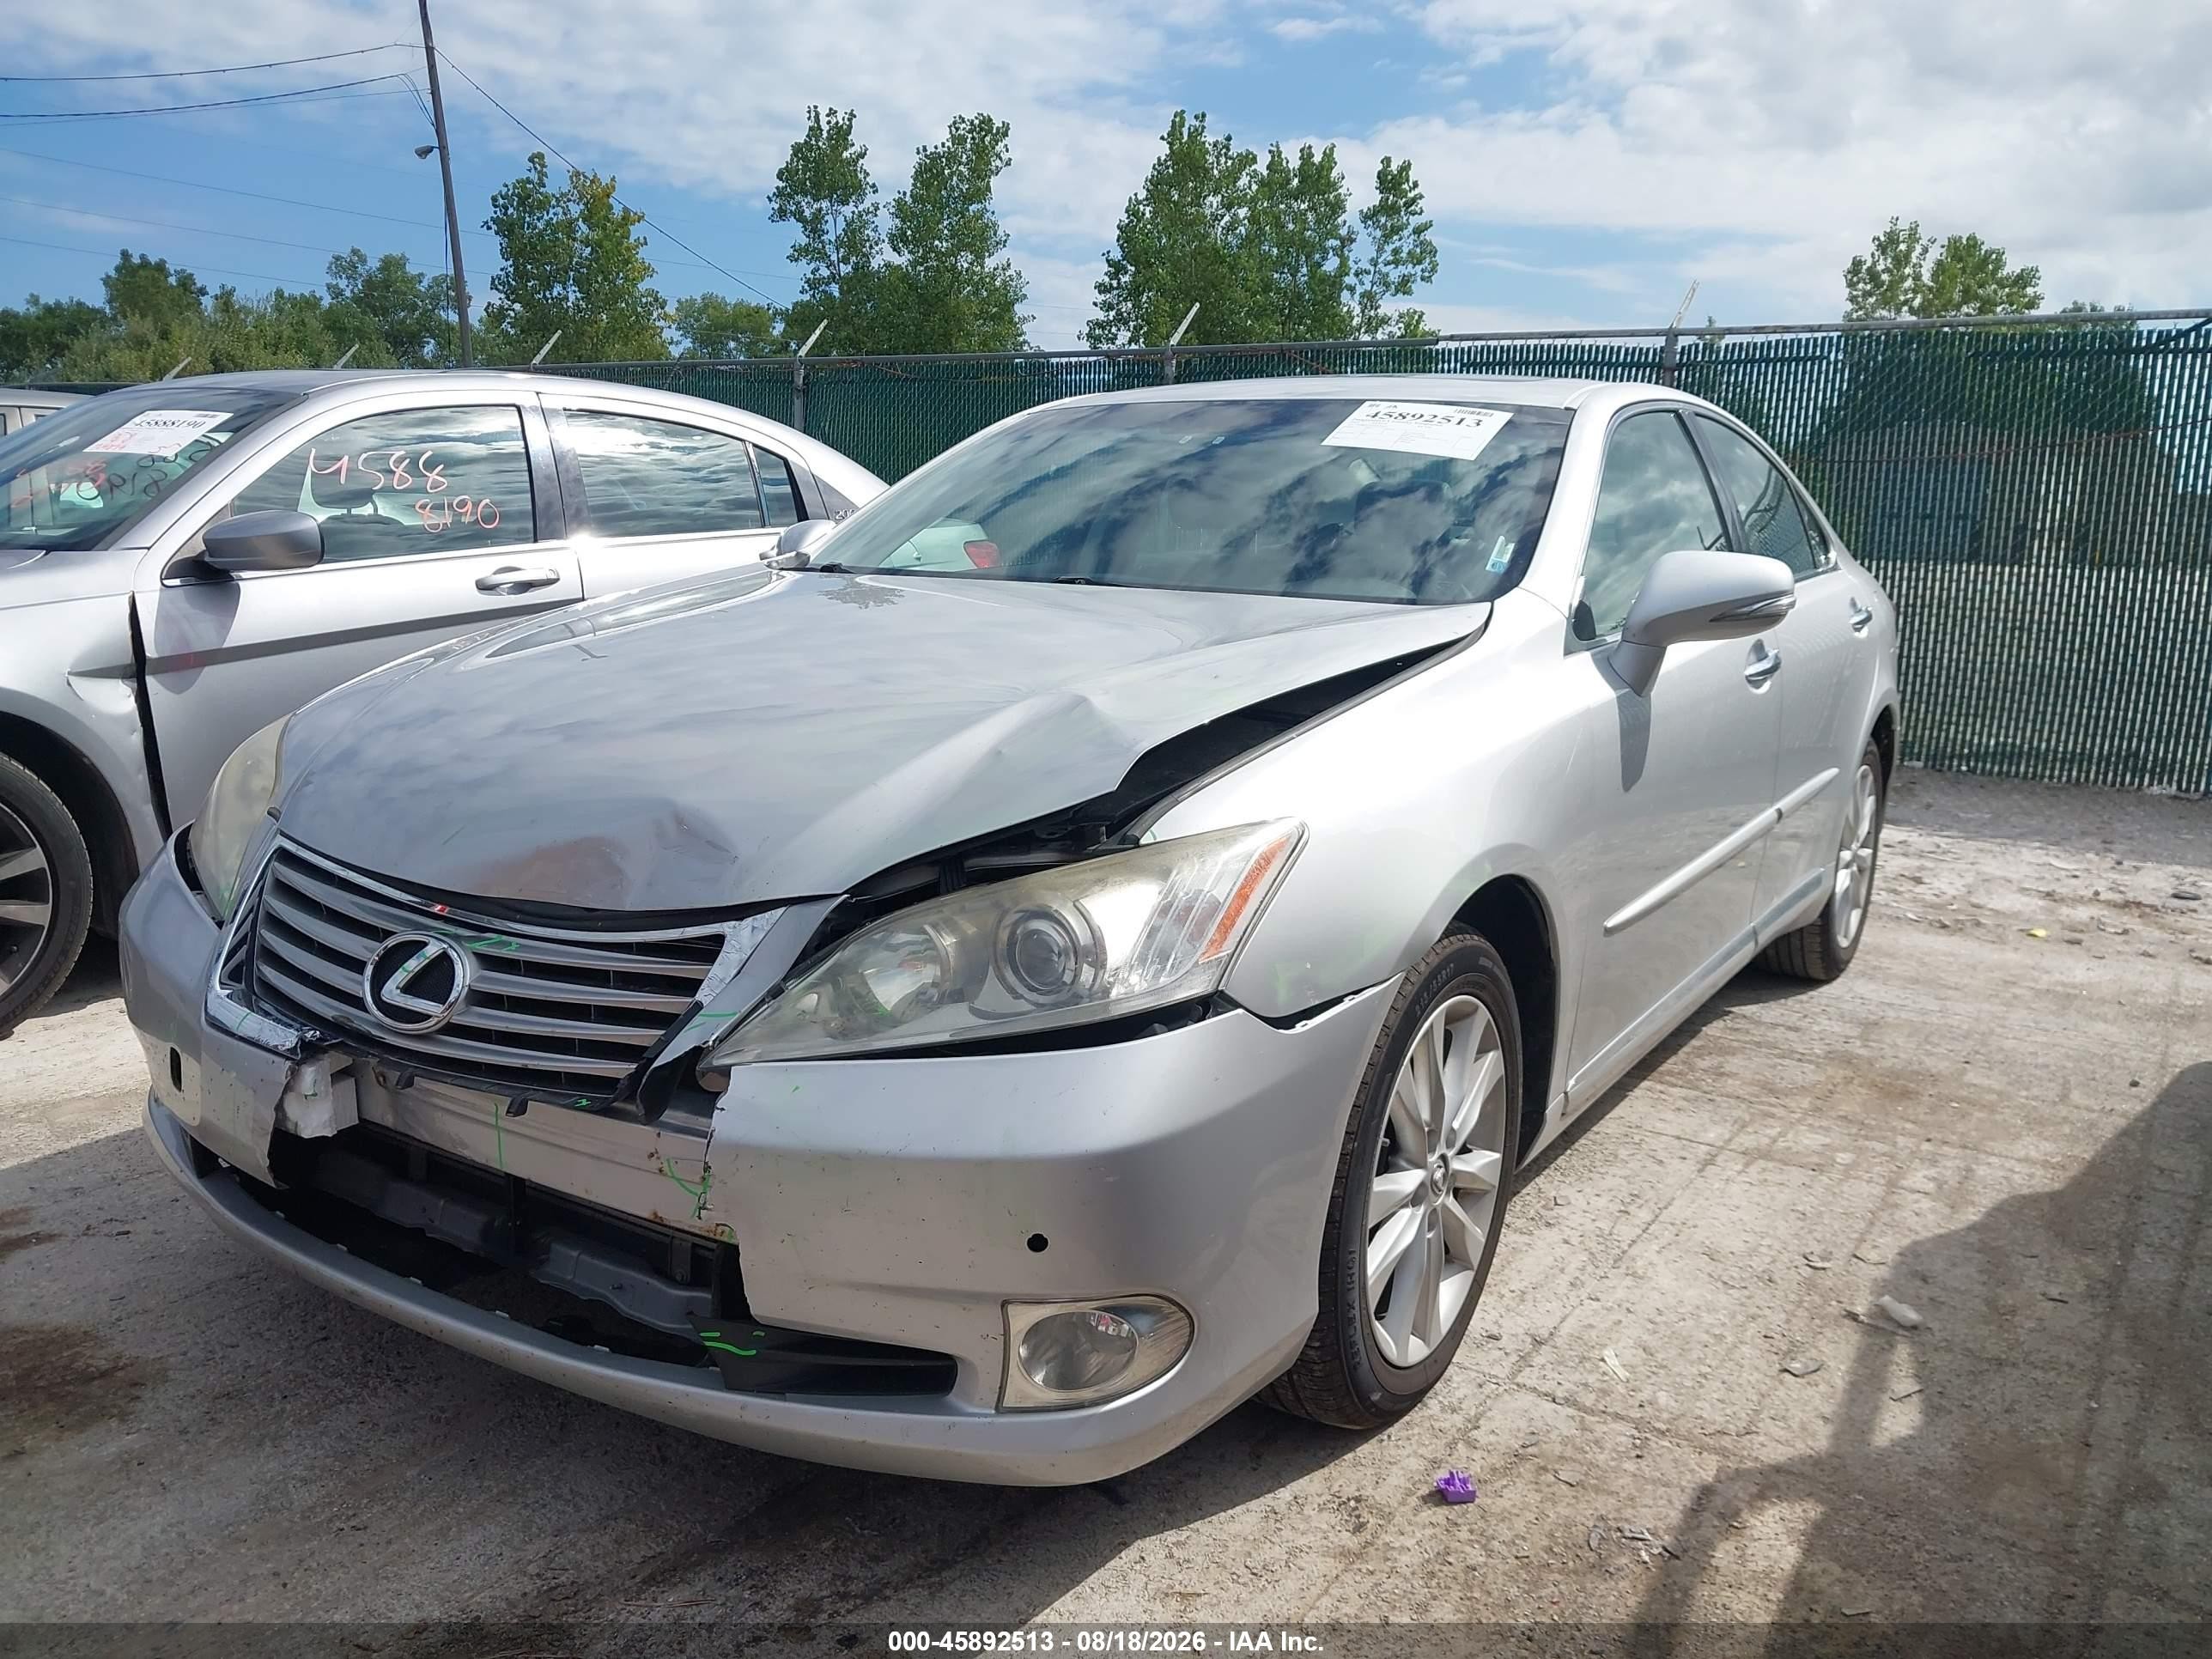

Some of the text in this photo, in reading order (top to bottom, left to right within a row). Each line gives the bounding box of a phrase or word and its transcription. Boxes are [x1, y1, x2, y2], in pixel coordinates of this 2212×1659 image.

[1365, 410, 1484, 428] 45892513
[310, 448, 447, 493] 4588
[416, 495, 500, 532] 8190
